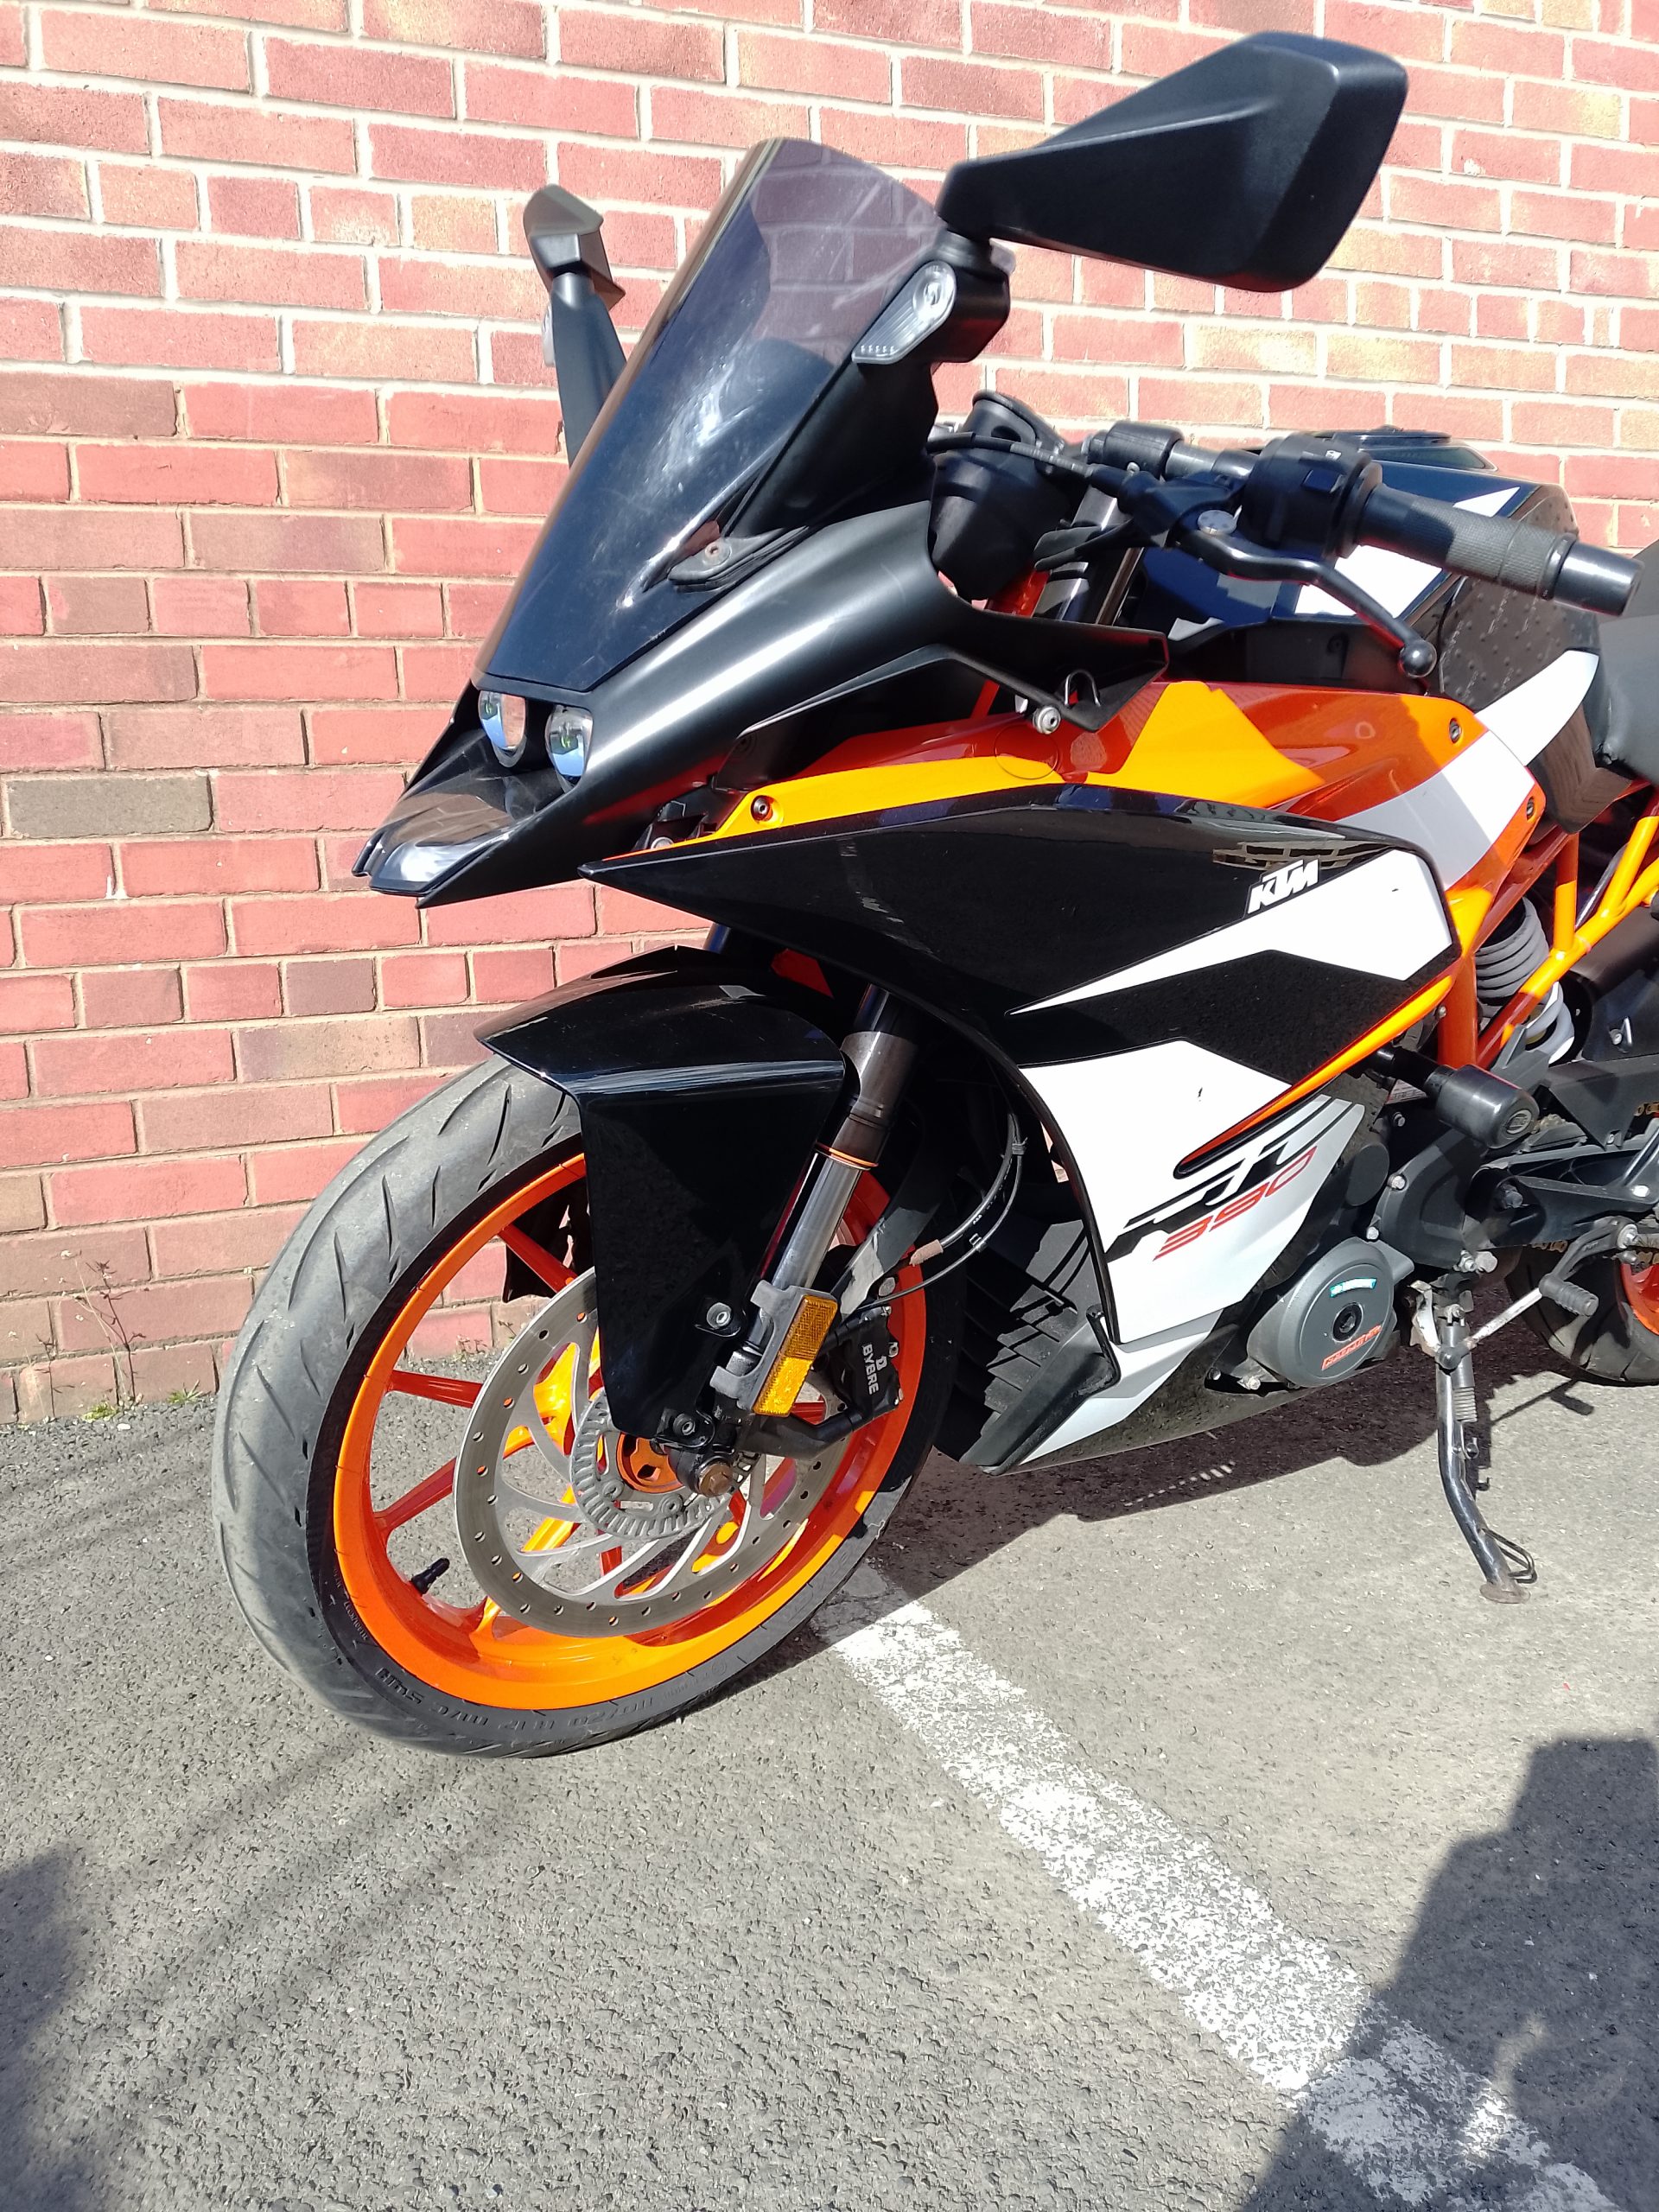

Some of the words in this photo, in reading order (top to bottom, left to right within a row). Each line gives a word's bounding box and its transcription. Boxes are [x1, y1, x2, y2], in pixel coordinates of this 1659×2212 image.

[1248, 859, 1319, 914] KTM
[1153, 1146, 1318, 1262] 390
[861, 1343, 880, 1395] BYBRE
